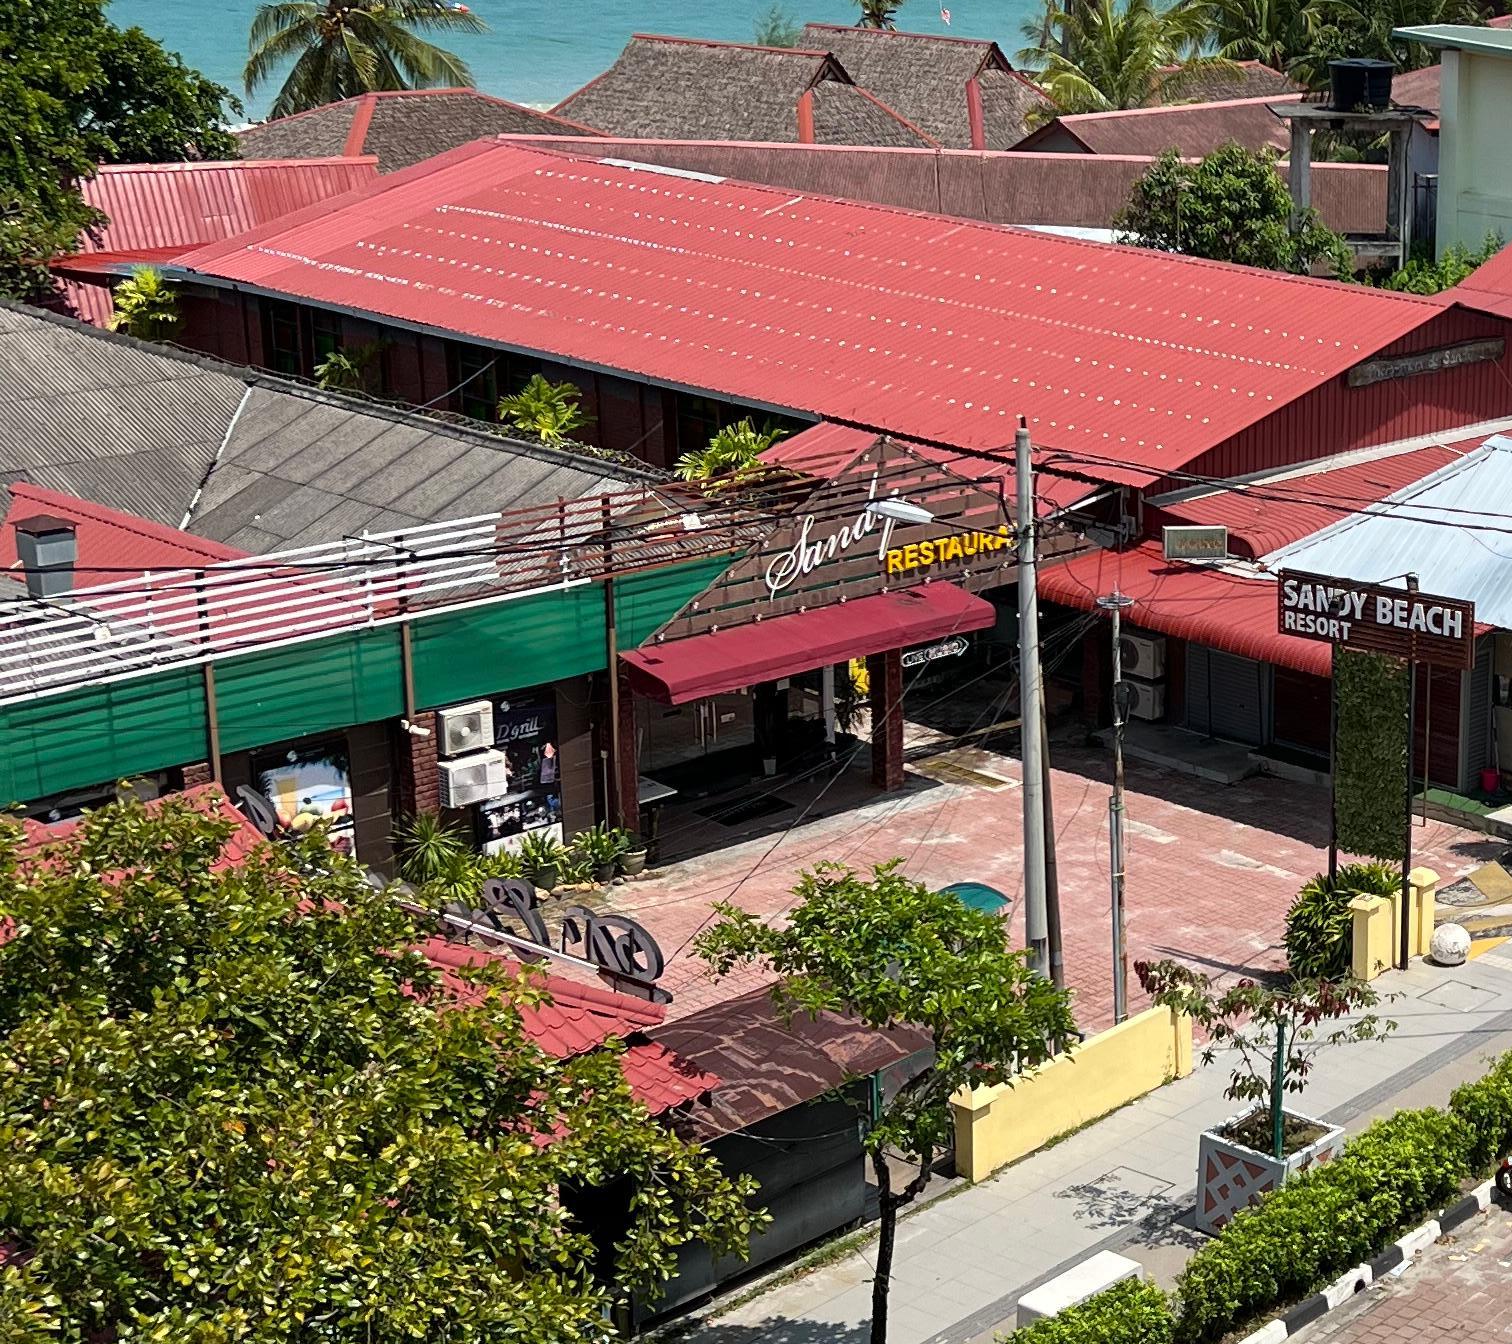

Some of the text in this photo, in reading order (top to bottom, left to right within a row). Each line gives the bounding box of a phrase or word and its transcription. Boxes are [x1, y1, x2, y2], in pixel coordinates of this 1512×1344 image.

[888, 524, 1010, 574] RESTAURA
[1283, 579, 1462, 639] SANDY BEACH
[1284, 610, 1352, 641] RESORT
